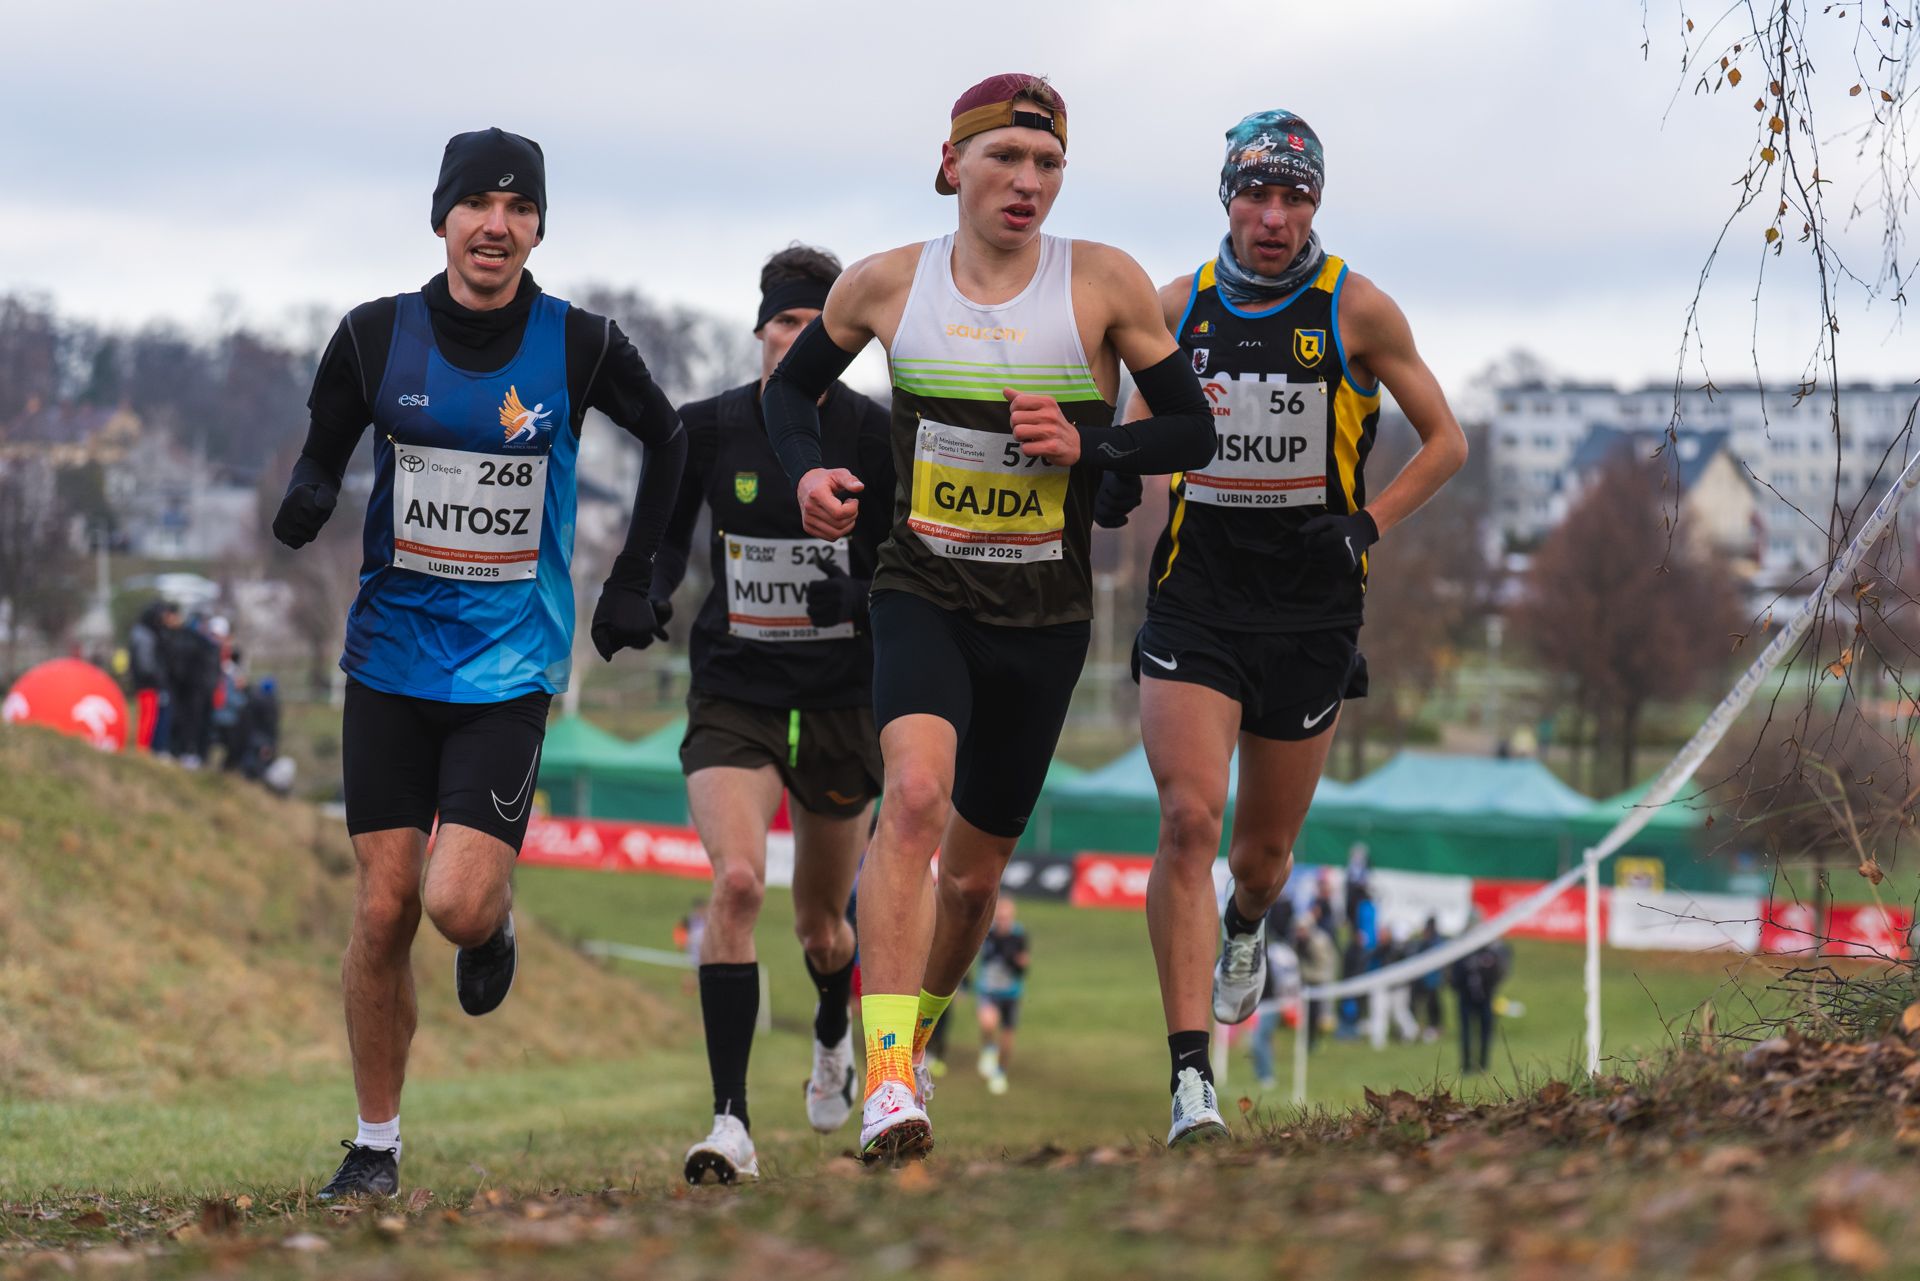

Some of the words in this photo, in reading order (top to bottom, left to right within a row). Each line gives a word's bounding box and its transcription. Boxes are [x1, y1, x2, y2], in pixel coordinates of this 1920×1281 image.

[1237, 158, 1257, 172] XVIII
[1261, 156, 1289, 165] BIEG
[946, 324, 1027, 344] saucony
[1305, 340, 1314, 351] Z
[398, 394, 429, 406] esa
[1269, 390, 1305, 414] 56
[1211, 407, 1230, 416] LEN
[940, 437, 973, 448] Ministerstwo
[1218, 434, 1307, 462] ISKUP
[939, 444, 955, 453] Sportu
[960, 448, 984, 457] Turystyki
[432, 464, 462, 475] Okęcie
[478, 461, 532, 486] 268
[934, 482, 1043, 517] GAJDA
[1217, 493, 1252, 503] LUBIN
[1256, 494, 1287, 503] 2025
[404, 499, 531, 535] ANTOSZ
[945, 544, 985, 556] LUBIN
[989, 548, 1022, 558] 2025
[429, 562, 464, 575] LUBIN
[467, 566, 499, 577] 2025
[734, 580, 808, 604] MUTW
[759, 629, 790, 638] LUBIN
[792, 628, 819, 637] 2025
